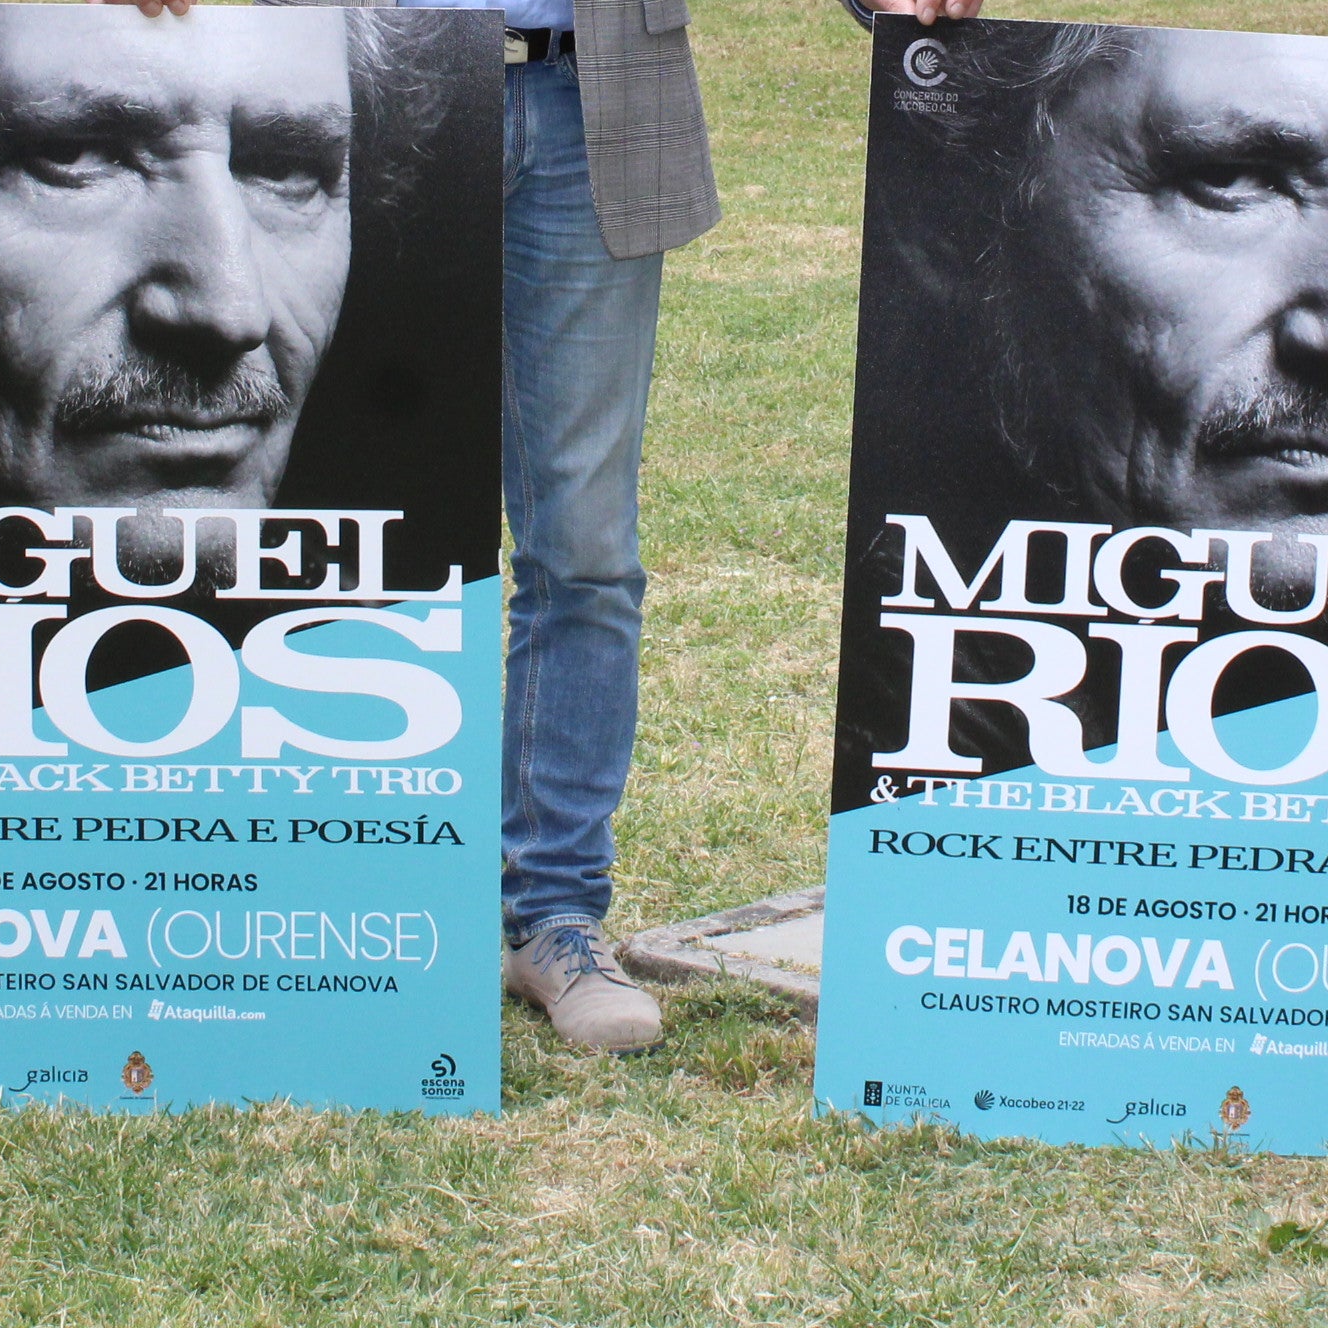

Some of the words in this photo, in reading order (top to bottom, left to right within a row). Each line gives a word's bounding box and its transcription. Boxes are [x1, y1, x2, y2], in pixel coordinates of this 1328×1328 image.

[893, 90, 943, 101] CONCERTOS
[946, 93, 959, 102] DO
[121, 764, 324, 794] BETTY
[332, 766, 463, 795] TRIO
[870, 775, 900, 803] &
[907, 776, 1032, 811] THE
[1038, 783, 1232, 820] BLACK
[72, 817, 239, 842] PEDRA
[247, 819, 278, 843] E
[288, 814, 465, 846] POESÍA
[868, 829, 1003, 860] ROCK
[1012, 836, 1177, 868] ENTRE
[21, 871, 125, 891] AGOSTO
[144, 872, 166, 891] 21
[174, 873, 258, 892] HORAS
[1068, 895, 1090, 915] 18
[1098, 897, 1127, 916] DE
[1134, 898, 1236, 920] AGOSTO
[1255, 903, 1277, 922] 21
[147, 907, 438, 971] (OURENSE)
[885, 924, 1234, 990] CELANOVA
[62, 973, 108, 991] SAN
[116, 973, 235, 992] SALVADOR
[243, 975, 269, 992] DE
[276, 974, 399, 993] CELANOVA
[55, 1004, 108, 1019] VENDA
[113, 1004, 133, 1019] EN
[163, 1005, 266, 1022] Ataquilla.com
[921, 992, 1040, 1014] CLAUSTRO
[1047, 999, 1161, 1020] MOSTEIRO
[1167, 1004, 1213, 1022] SAN
[1059, 1031, 1140, 1049] ENTRADAS
[1158, 1035, 1211, 1052] VENDA
[1215, 1037, 1235, 1052] EN
[10, 1066, 88, 1092] galicia
[421, 1079, 465, 1087] escena
[887, 1084, 927, 1096] XUNTA
[885, 1096, 902, 1107] DE
[904, 1097, 951, 1109] GALICIA
[999, 1095, 1055, 1110] Xacobeo
[1106, 1099, 1186, 1123] galicia
